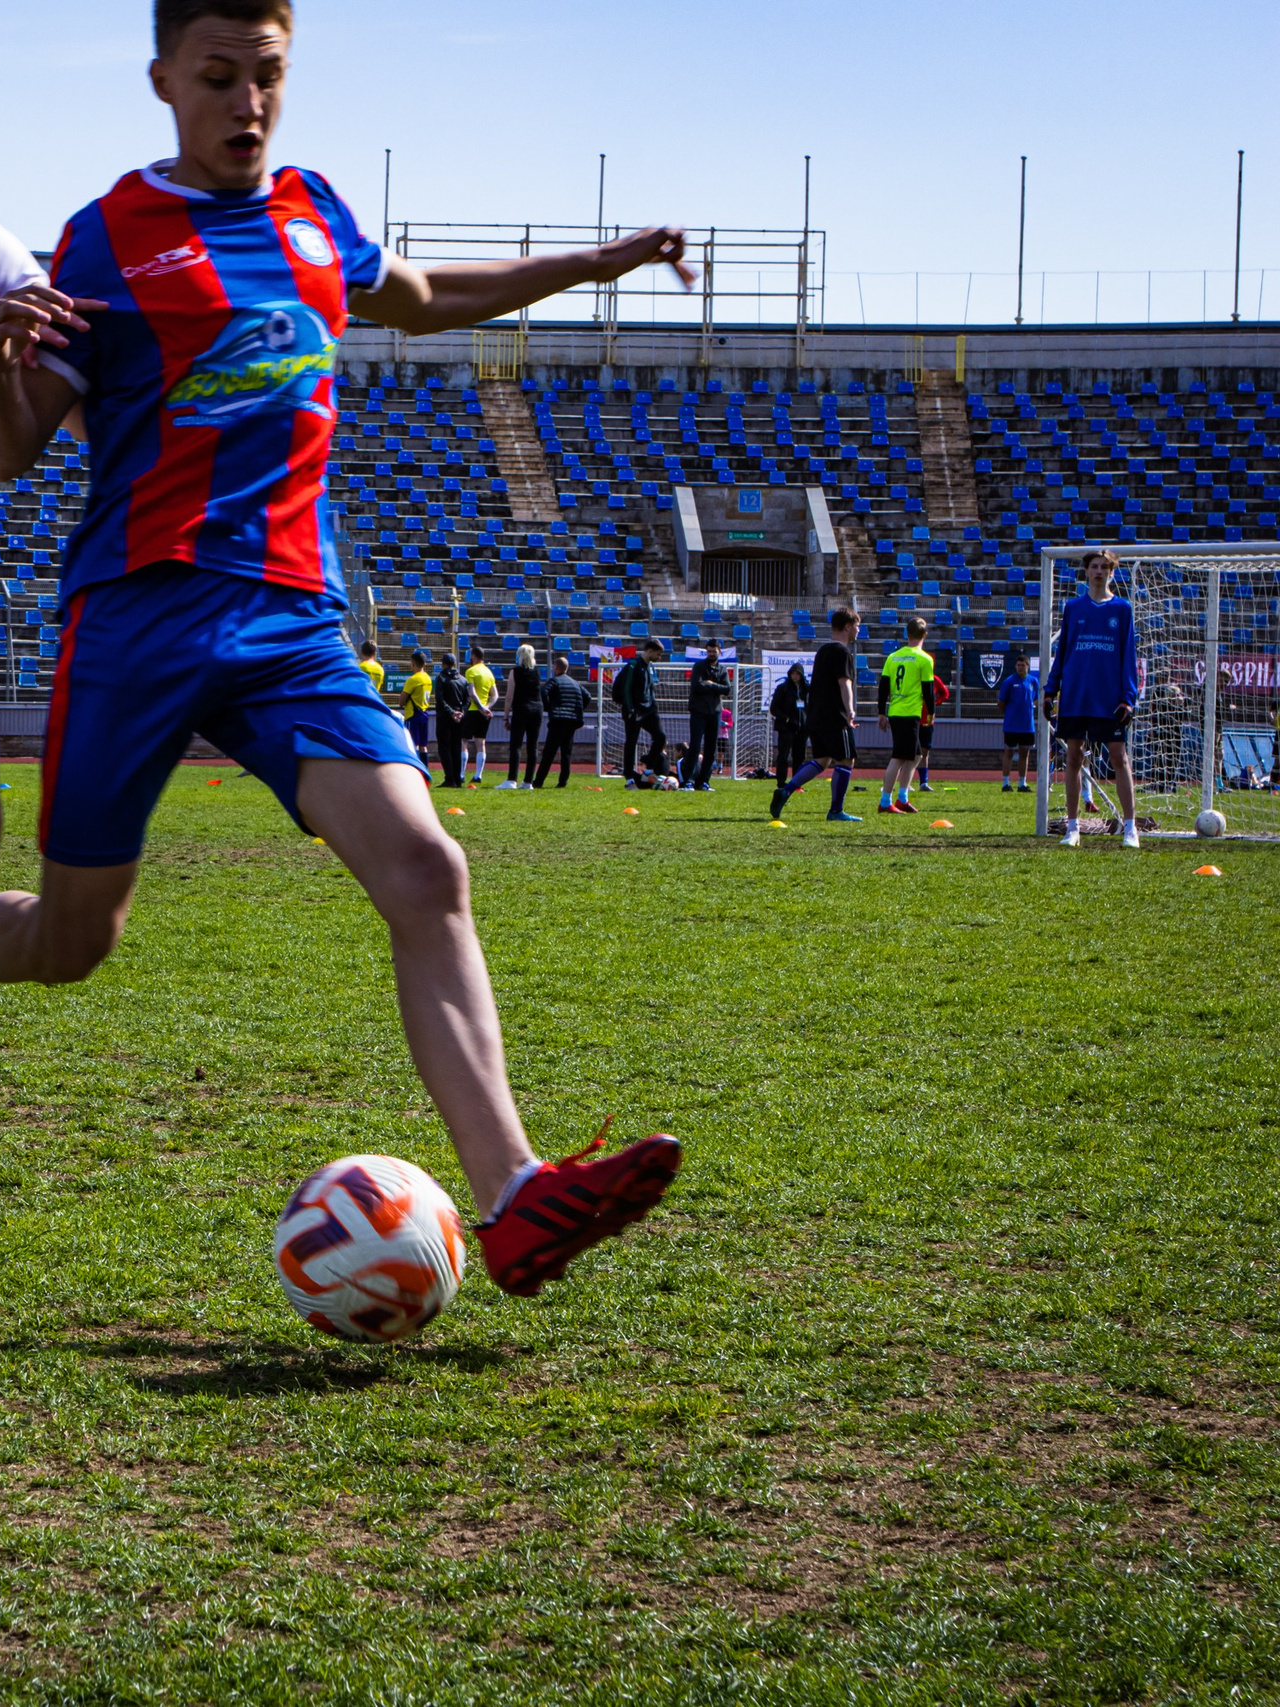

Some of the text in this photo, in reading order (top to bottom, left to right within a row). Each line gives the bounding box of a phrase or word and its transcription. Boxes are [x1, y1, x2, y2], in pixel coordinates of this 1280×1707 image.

[742, 495, 758, 506] 12
[1076, 641, 1115, 652] ДОБРЯКОВ
[767, 656, 795, 665] Ultras
